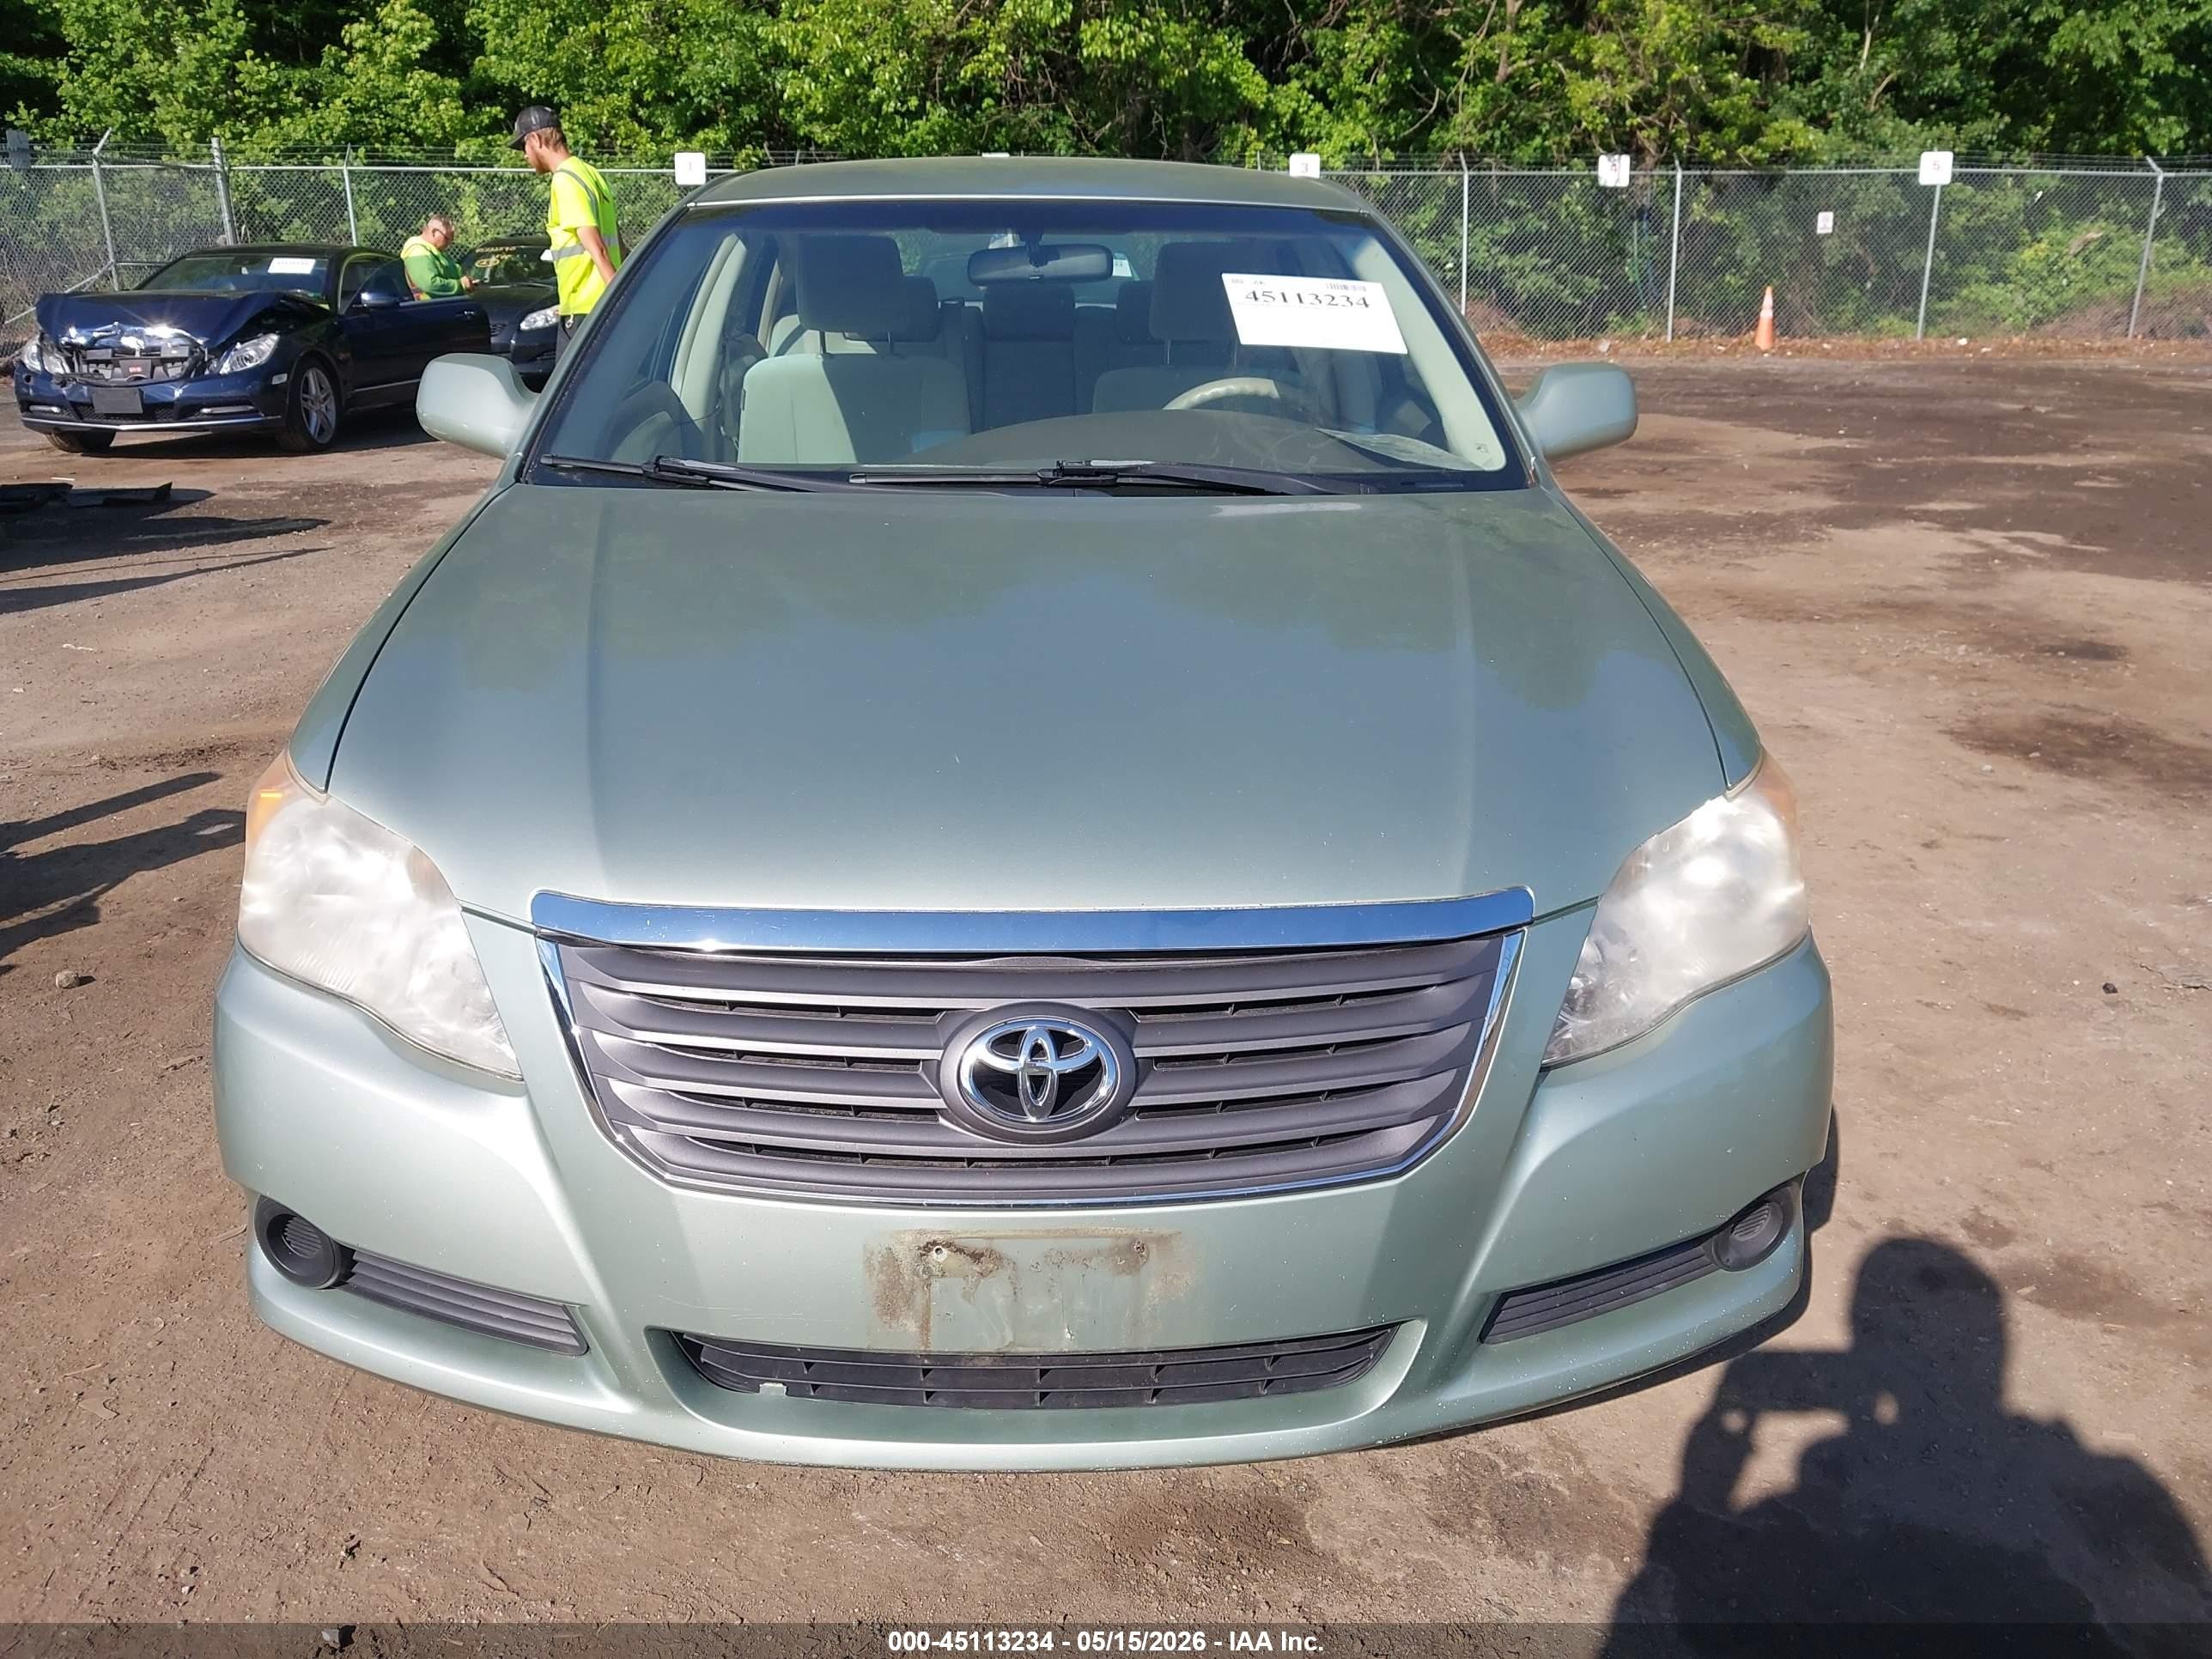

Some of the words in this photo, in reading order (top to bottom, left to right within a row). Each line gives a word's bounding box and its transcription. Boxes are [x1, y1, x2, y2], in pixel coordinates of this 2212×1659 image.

[1301, 162, 1309, 173] 3
[1932, 160, 1941, 171] 5
[1244, 289, 1370, 309] 45113234
